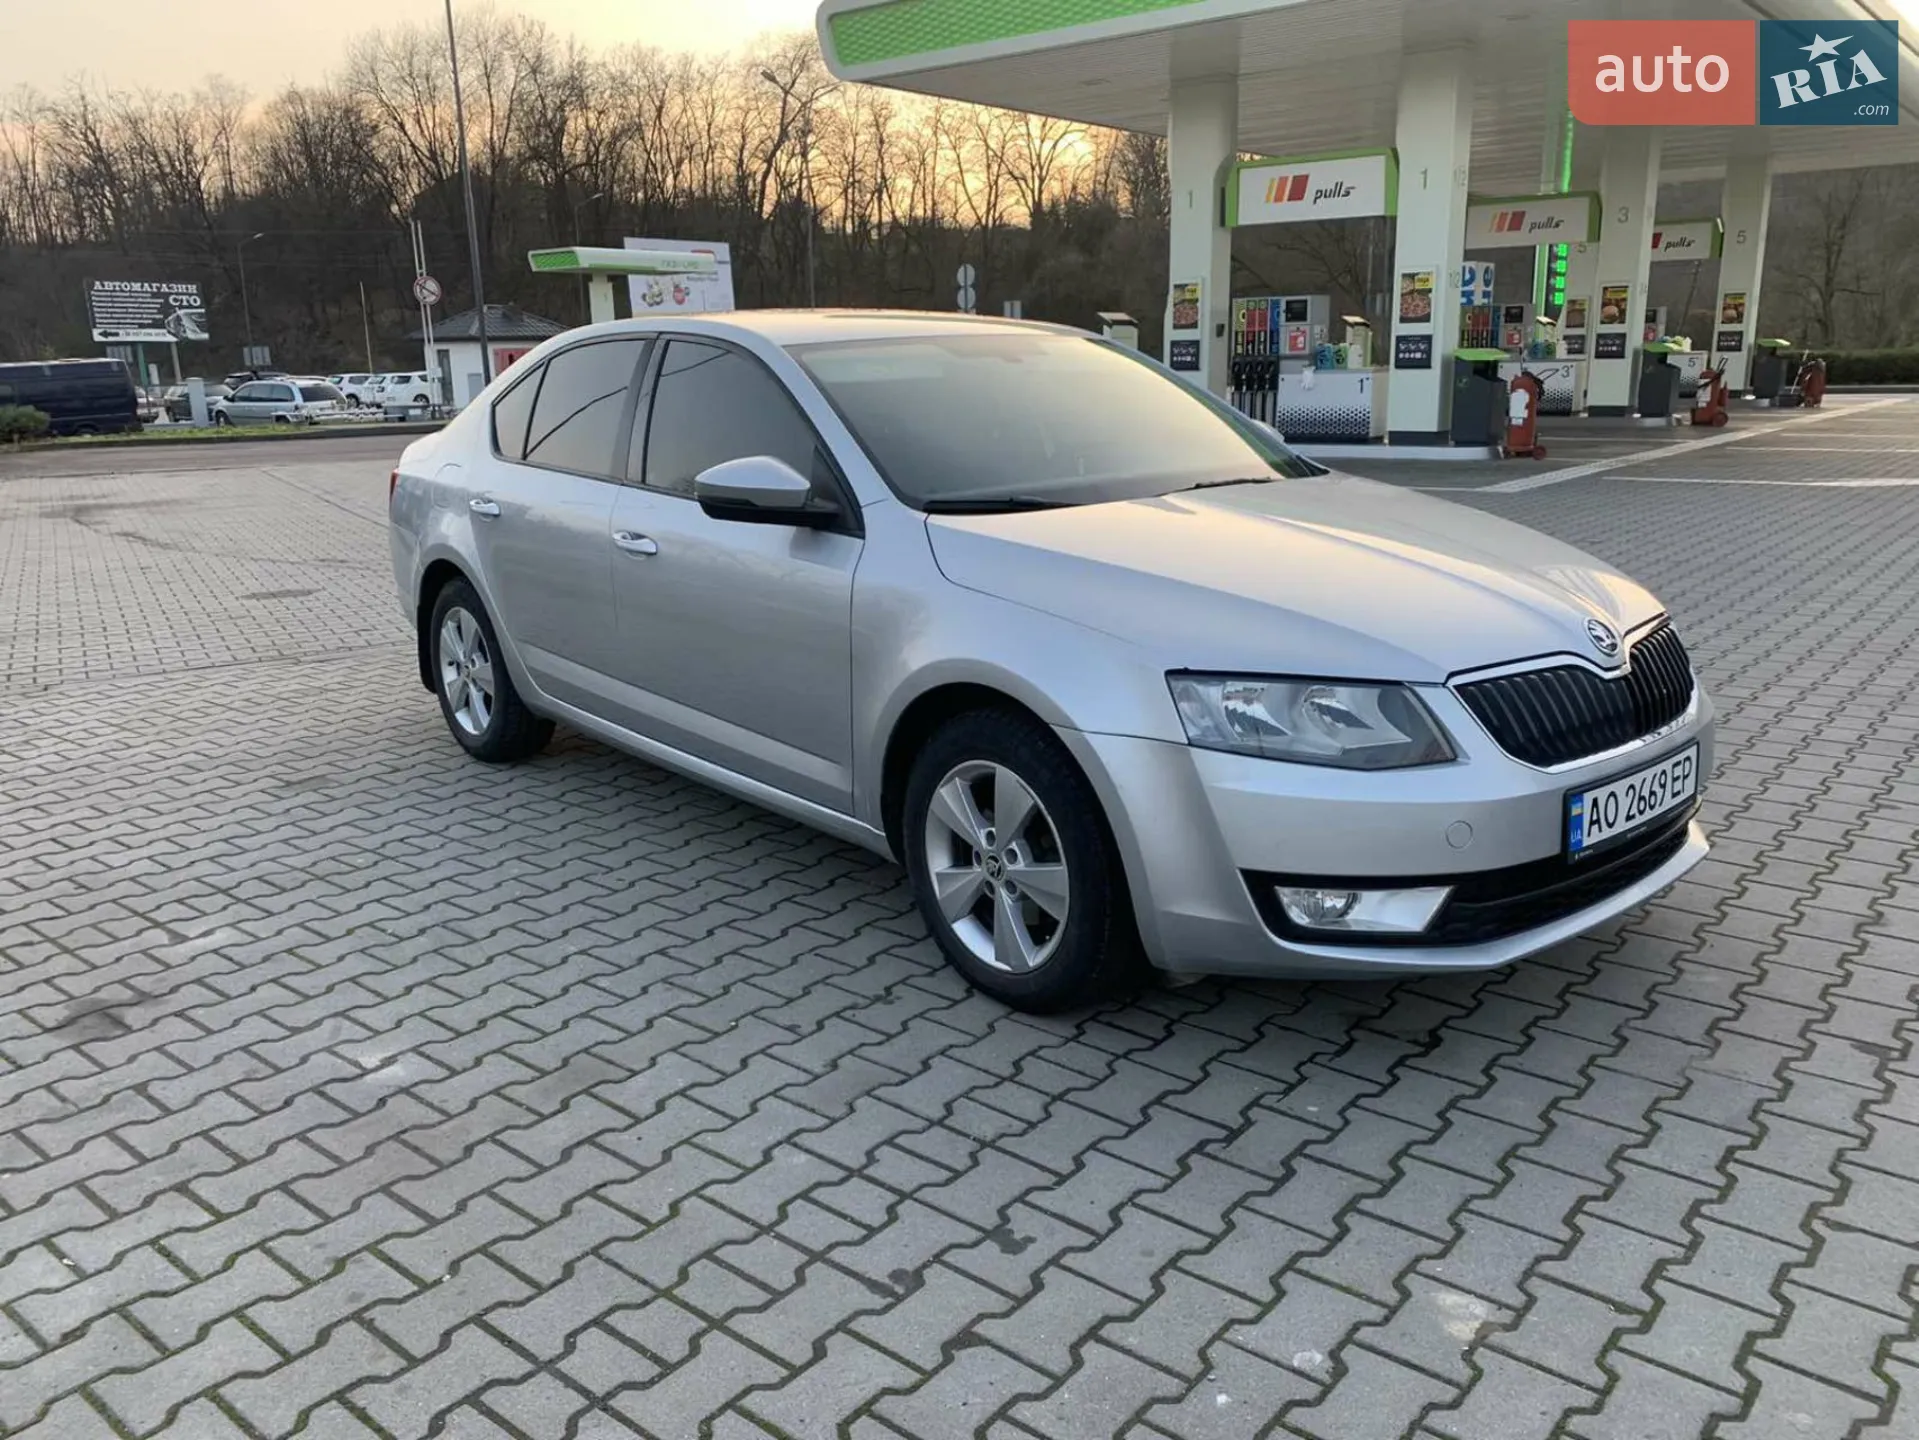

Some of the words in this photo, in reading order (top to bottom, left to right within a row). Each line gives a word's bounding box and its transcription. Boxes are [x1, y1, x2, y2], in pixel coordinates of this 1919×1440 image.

[1313, 181, 1356, 204] pulls
[1617, 206, 1629, 223] 3
[1528, 216, 1564, 233] pulls
[1664, 236, 1696, 252] pulls
[1736, 229, 1747, 244] 5
[93, 281, 198, 293] АВТОМАГАЗИН
[168, 295, 201, 306] СТО
[1587, 791, 1619, 837] AO
[1625, 769, 1668, 823] 2669
[1671, 755, 1693, 800] EP
[1571, 828, 1582, 842] UA
